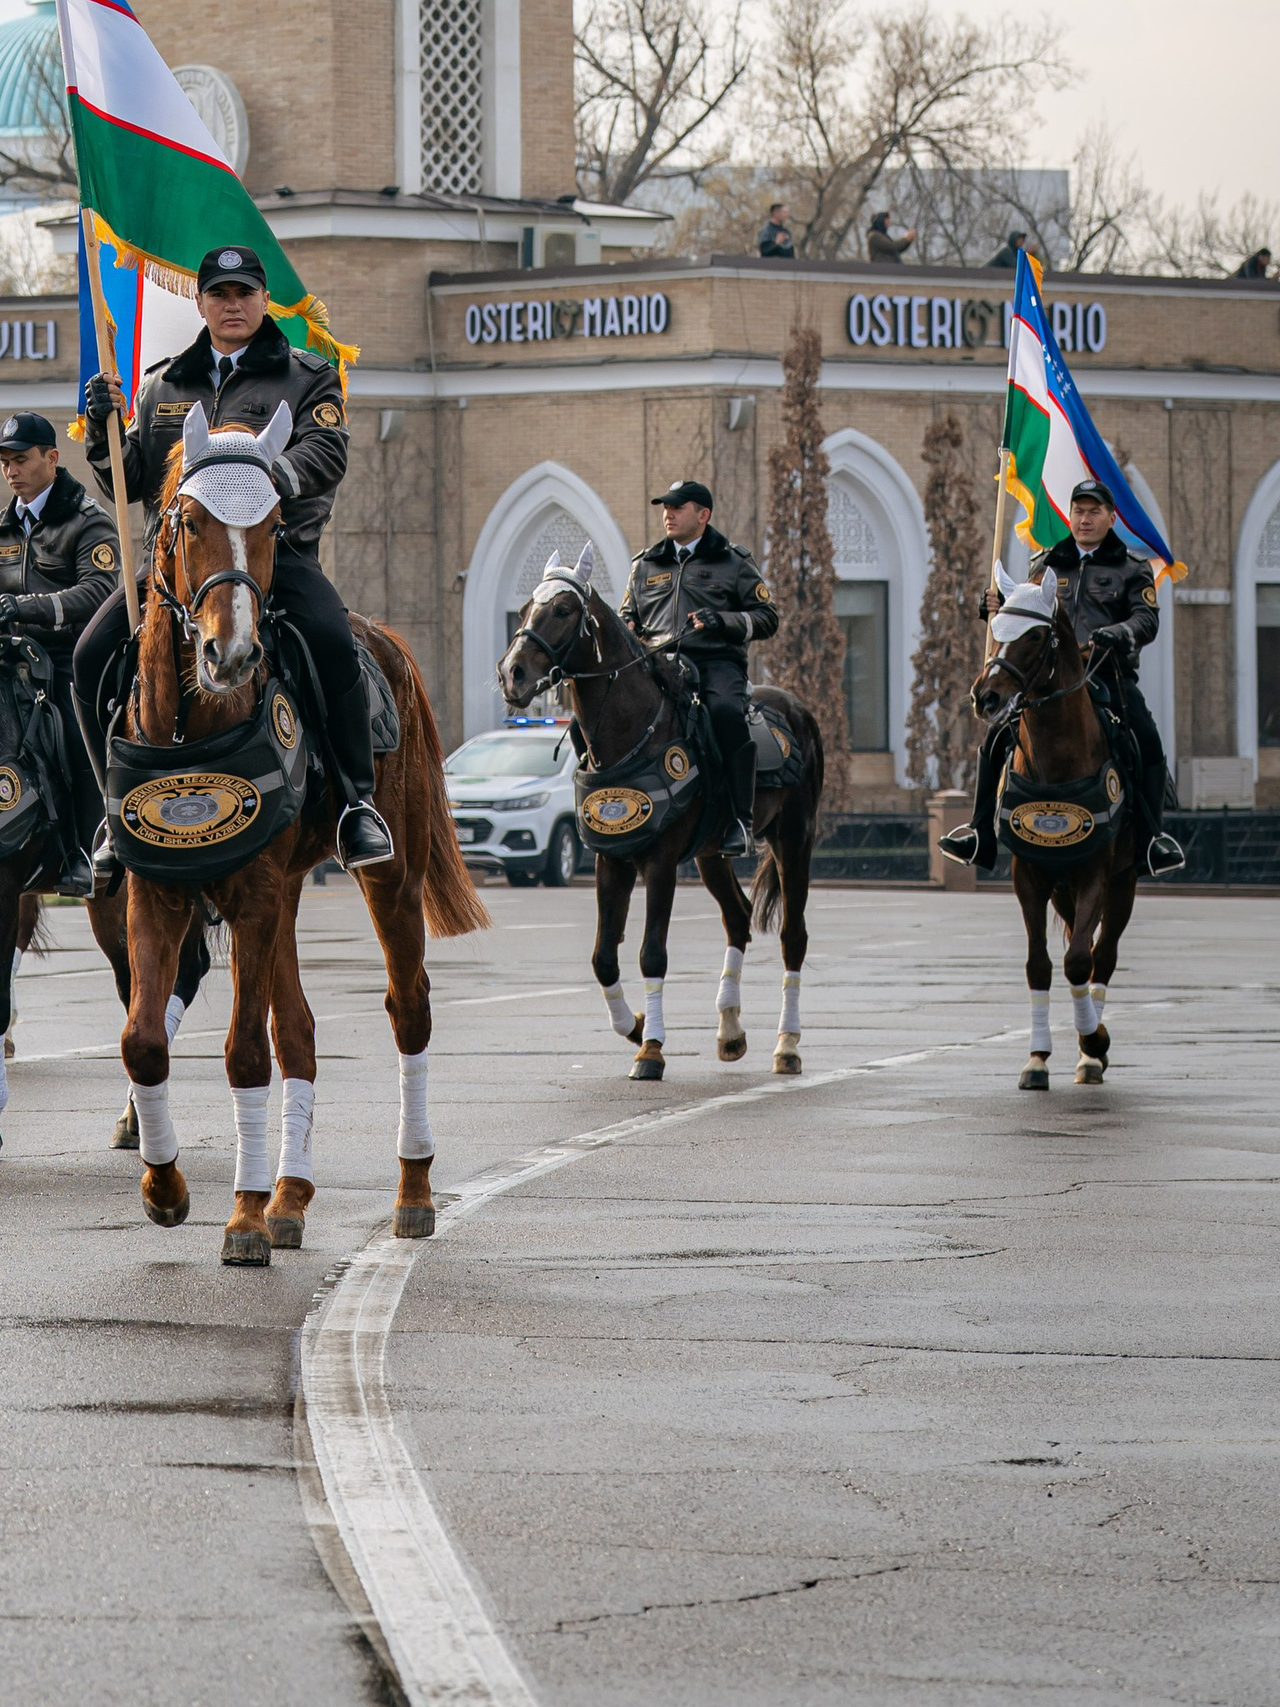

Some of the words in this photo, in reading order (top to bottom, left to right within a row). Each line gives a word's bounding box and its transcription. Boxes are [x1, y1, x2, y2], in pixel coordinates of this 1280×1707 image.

[583, 293, 668, 338] MARIO
[183, 776, 254, 799] RESPUBLIKASI
[136, 826, 160, 842] ICHKI
[163, 837, 203, 845] ISHLAR
[206, 814, 250, 841] VAZIRLIGI
